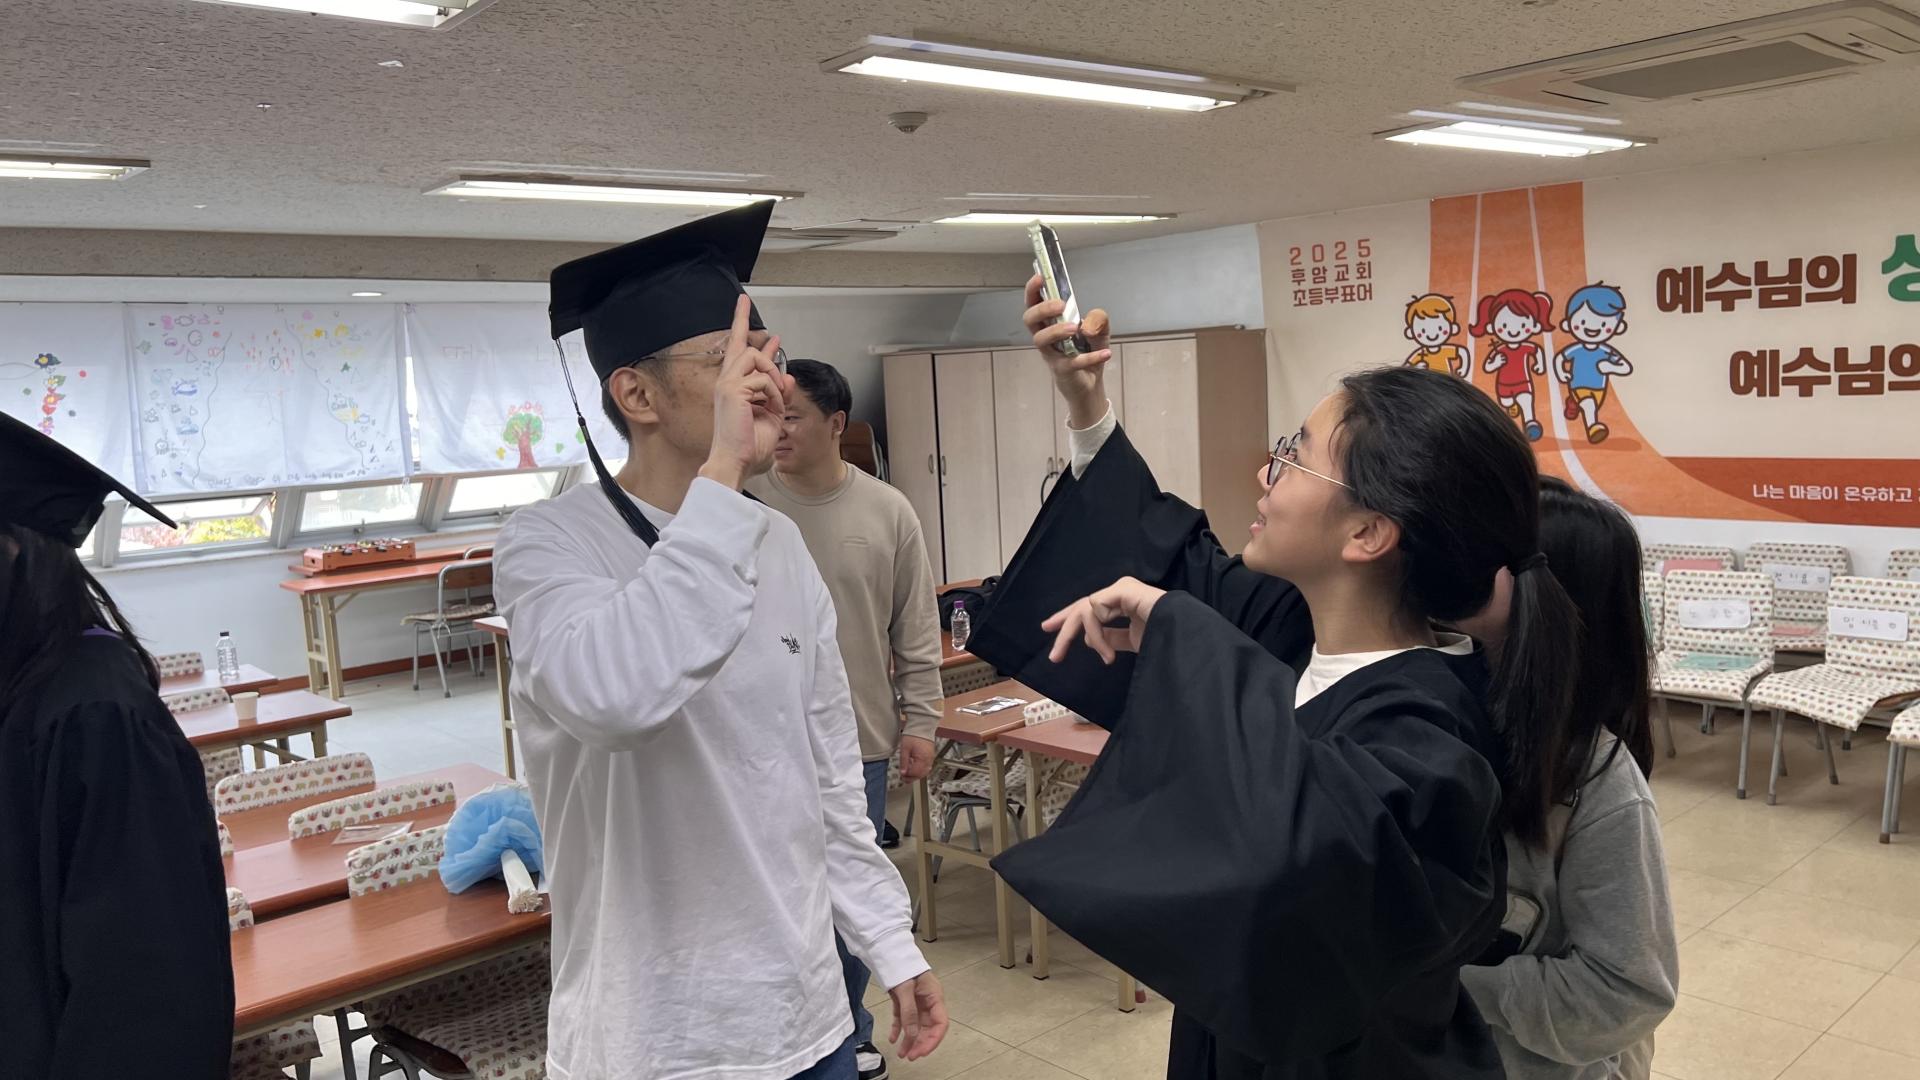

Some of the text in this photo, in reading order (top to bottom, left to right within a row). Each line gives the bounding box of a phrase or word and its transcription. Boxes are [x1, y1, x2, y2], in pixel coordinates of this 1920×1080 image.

[1289, 238, 1371, 266] 2025
[1656, 253, 1857, 314] 예수님의
[1753, 484, 1913, 502] 나는 마음이 온유하고
